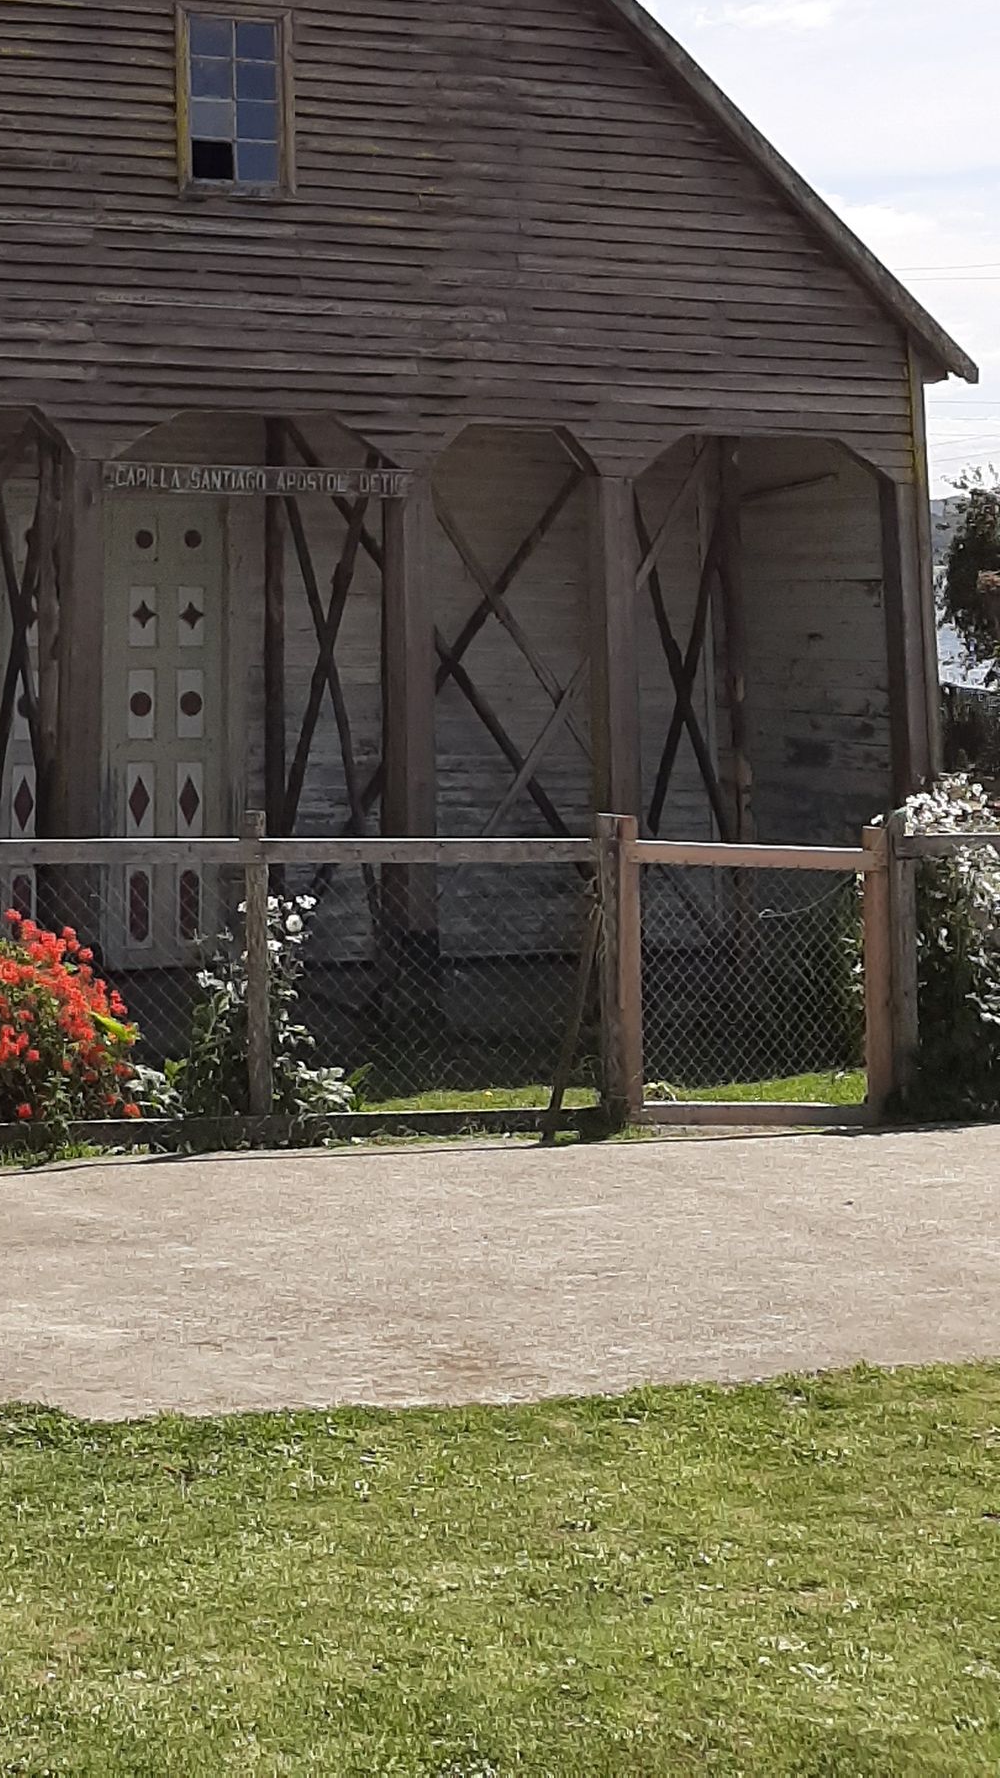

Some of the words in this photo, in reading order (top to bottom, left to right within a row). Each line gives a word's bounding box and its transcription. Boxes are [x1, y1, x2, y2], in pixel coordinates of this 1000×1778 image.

[115, 465, 180, 489] CAPILLA
[190, 466, 267, 491] SANTIAGO
[276, 471, 346, 493] APOSTOL
